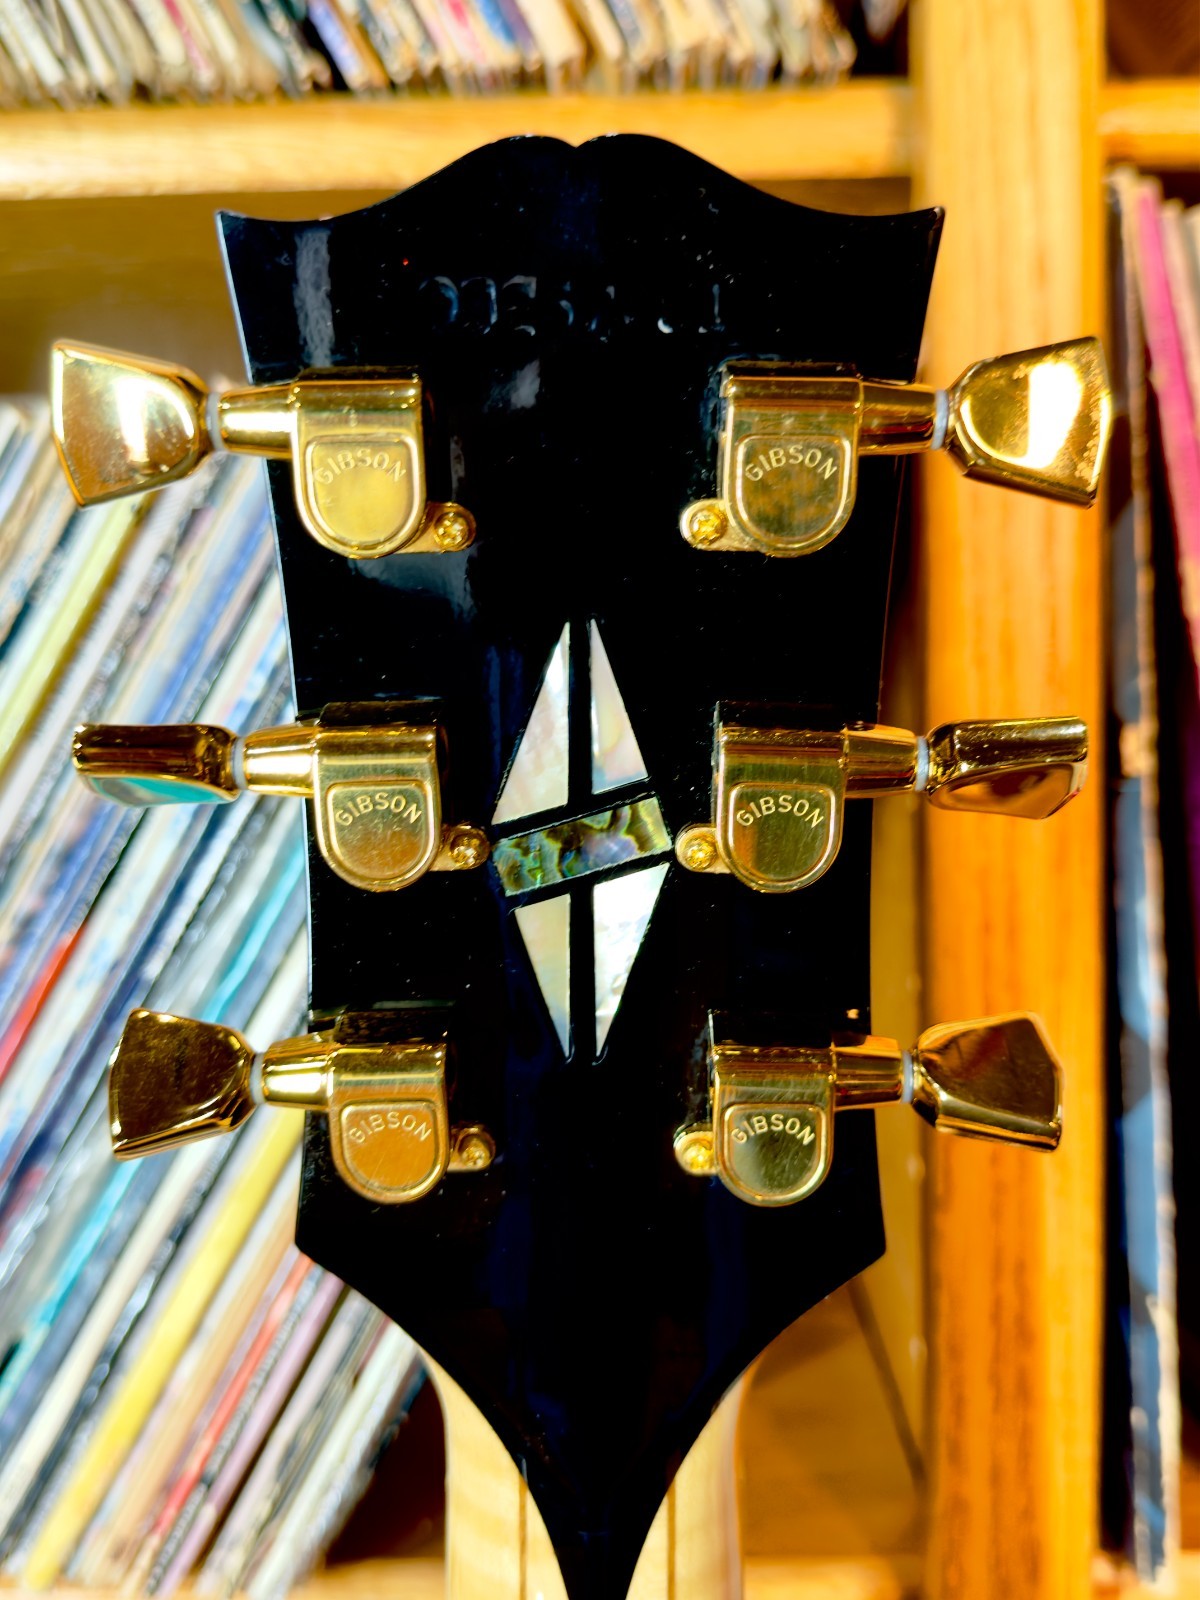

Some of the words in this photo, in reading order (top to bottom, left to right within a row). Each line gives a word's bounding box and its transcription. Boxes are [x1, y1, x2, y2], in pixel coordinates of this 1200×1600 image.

[313, 448, 406, 484] GIBSON
[745, 445, 837, 481] GIBSON
[335, 792, 422, 826] GIBSON
[736, 795, 824, 829] GIBSON
[348, 1111, 432, 1143] GIBSON
[731, 1113, 816, 1145] GIBSON
